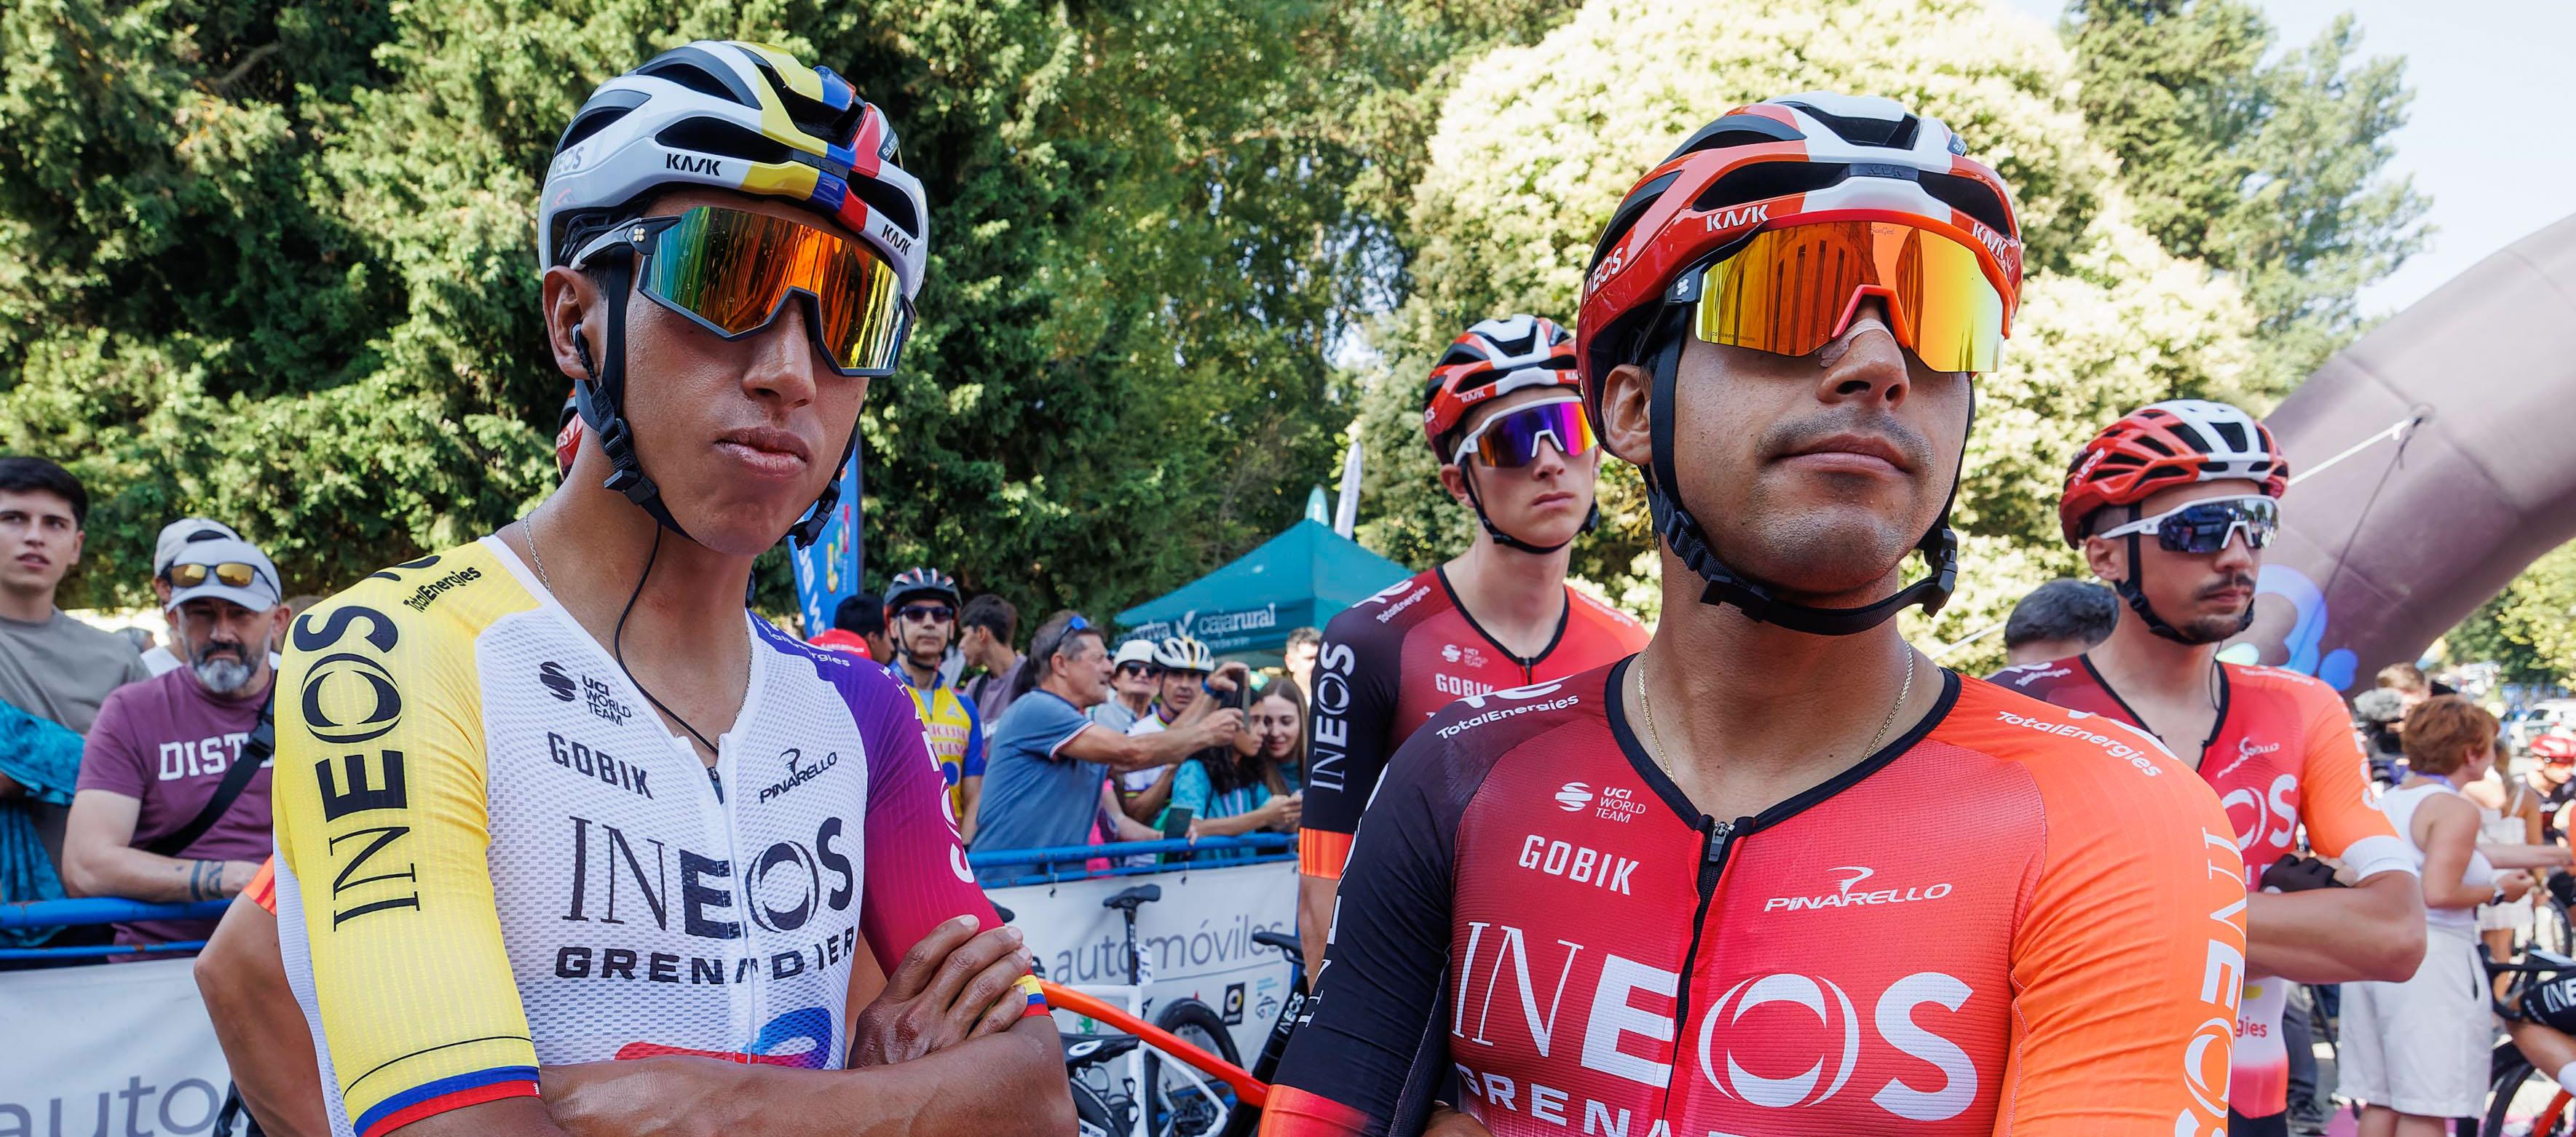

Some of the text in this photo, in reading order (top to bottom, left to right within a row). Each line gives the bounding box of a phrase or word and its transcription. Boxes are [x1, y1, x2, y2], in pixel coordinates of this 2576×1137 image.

[666, 153, 722, 176] KASK
[882, 224, 911, 255] KASK
[1707, 205, 1769, 232] KASK
[1972, 222, 2007, 258] KASK
[403, 566, 482, 613] TotalEnergies
[582, 675, 610, 697] UCI
[583, 686, 632, 718] WORLD
[586, 700, 623, 726] TEAM
[1310, 641, 1356, 794] INEOS
[1436, 694, 1580, 739] TotalEnergies
[159, 732, 274, 780] DIST
[548, 731, 654, 800] GOBIK
[1996, 710, 2162, 777] TotalEnergies
[293, 605, 420, 932] INEOS
[759, 751, 837, 804] PINARELLO
[1595, 807, 1631, 823] TEAM
[1600, 796, 1646, 815] WORLD
[1603, 786, 1632, 800] UCI
[562, 815, 854, 940] INEOS
[1518, 834, 1640, 896] GOBIK
[1763, 882, 1953, 912] PINARELLO
[1278, 991, 1305, 1034] INEOS
[1452, 922, 1979, 1122] INEOS
[0, 1076, 242, 1137] auto
